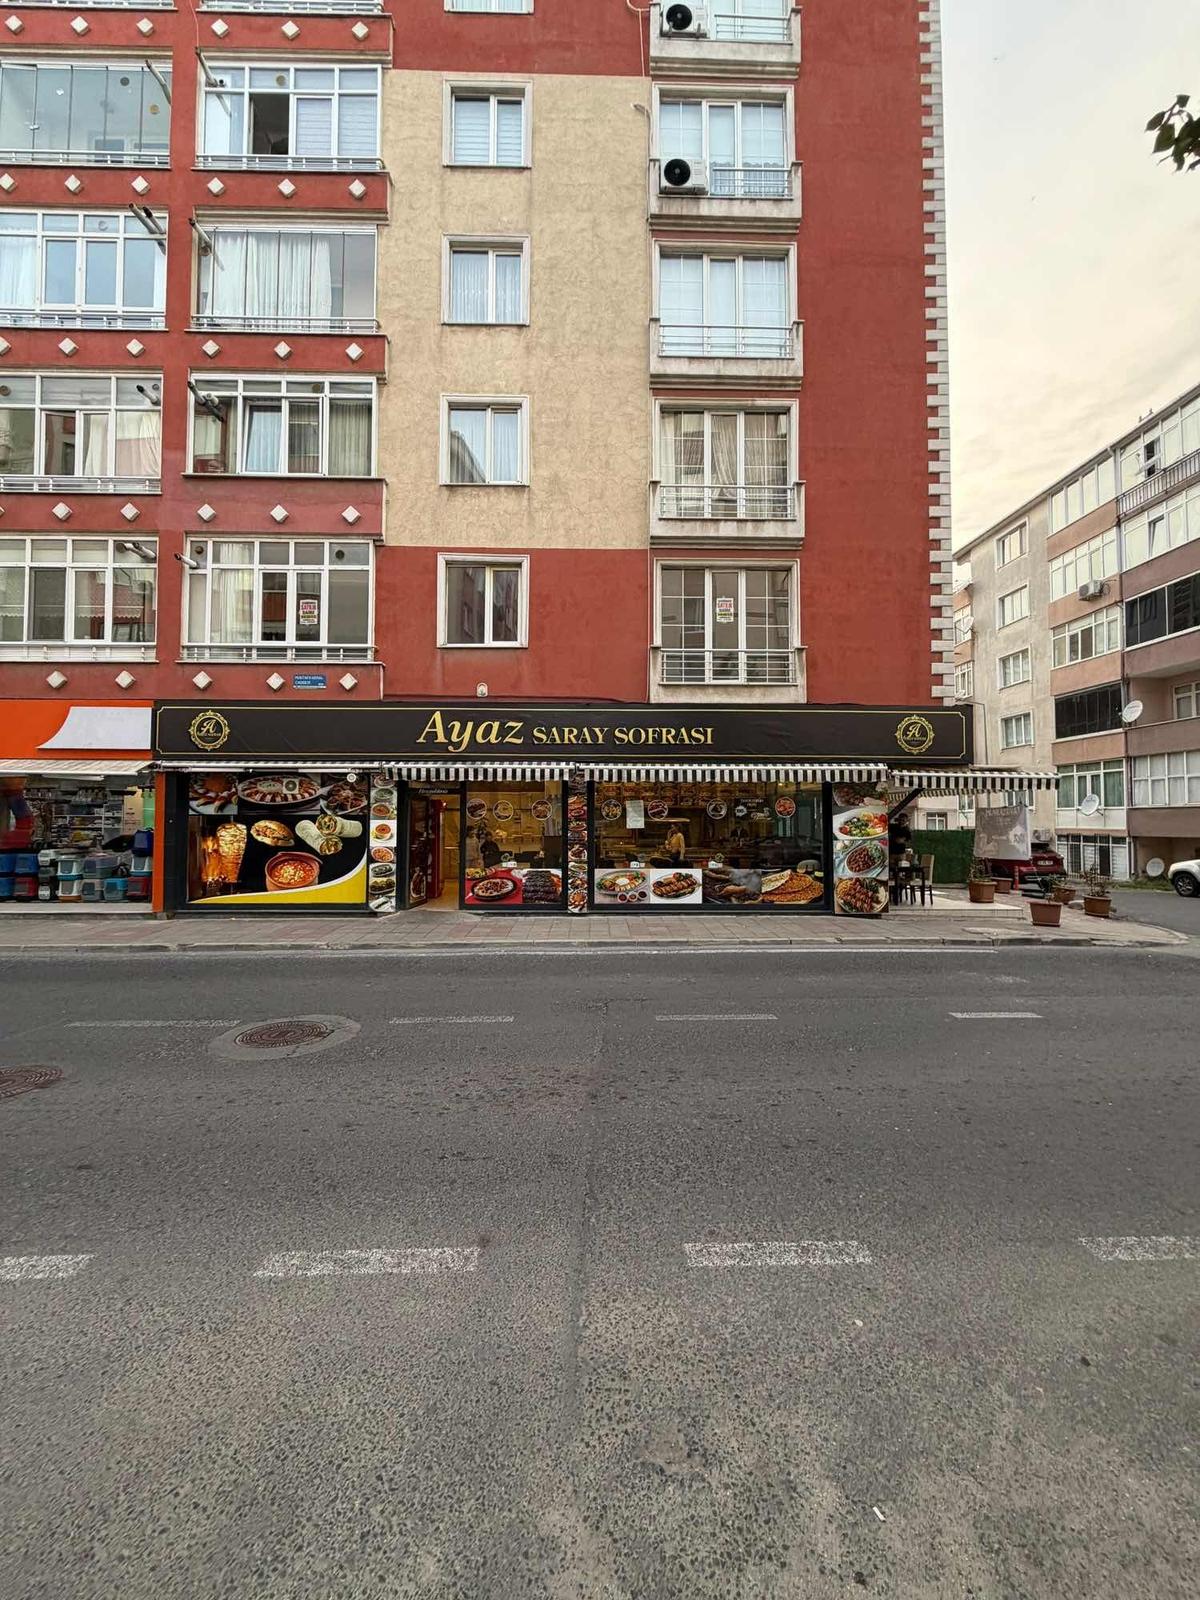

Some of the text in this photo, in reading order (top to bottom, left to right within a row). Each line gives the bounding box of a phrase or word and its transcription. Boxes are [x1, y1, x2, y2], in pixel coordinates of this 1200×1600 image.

[416, 711, 715, 752] Ayaz SARAY SOFRASI
